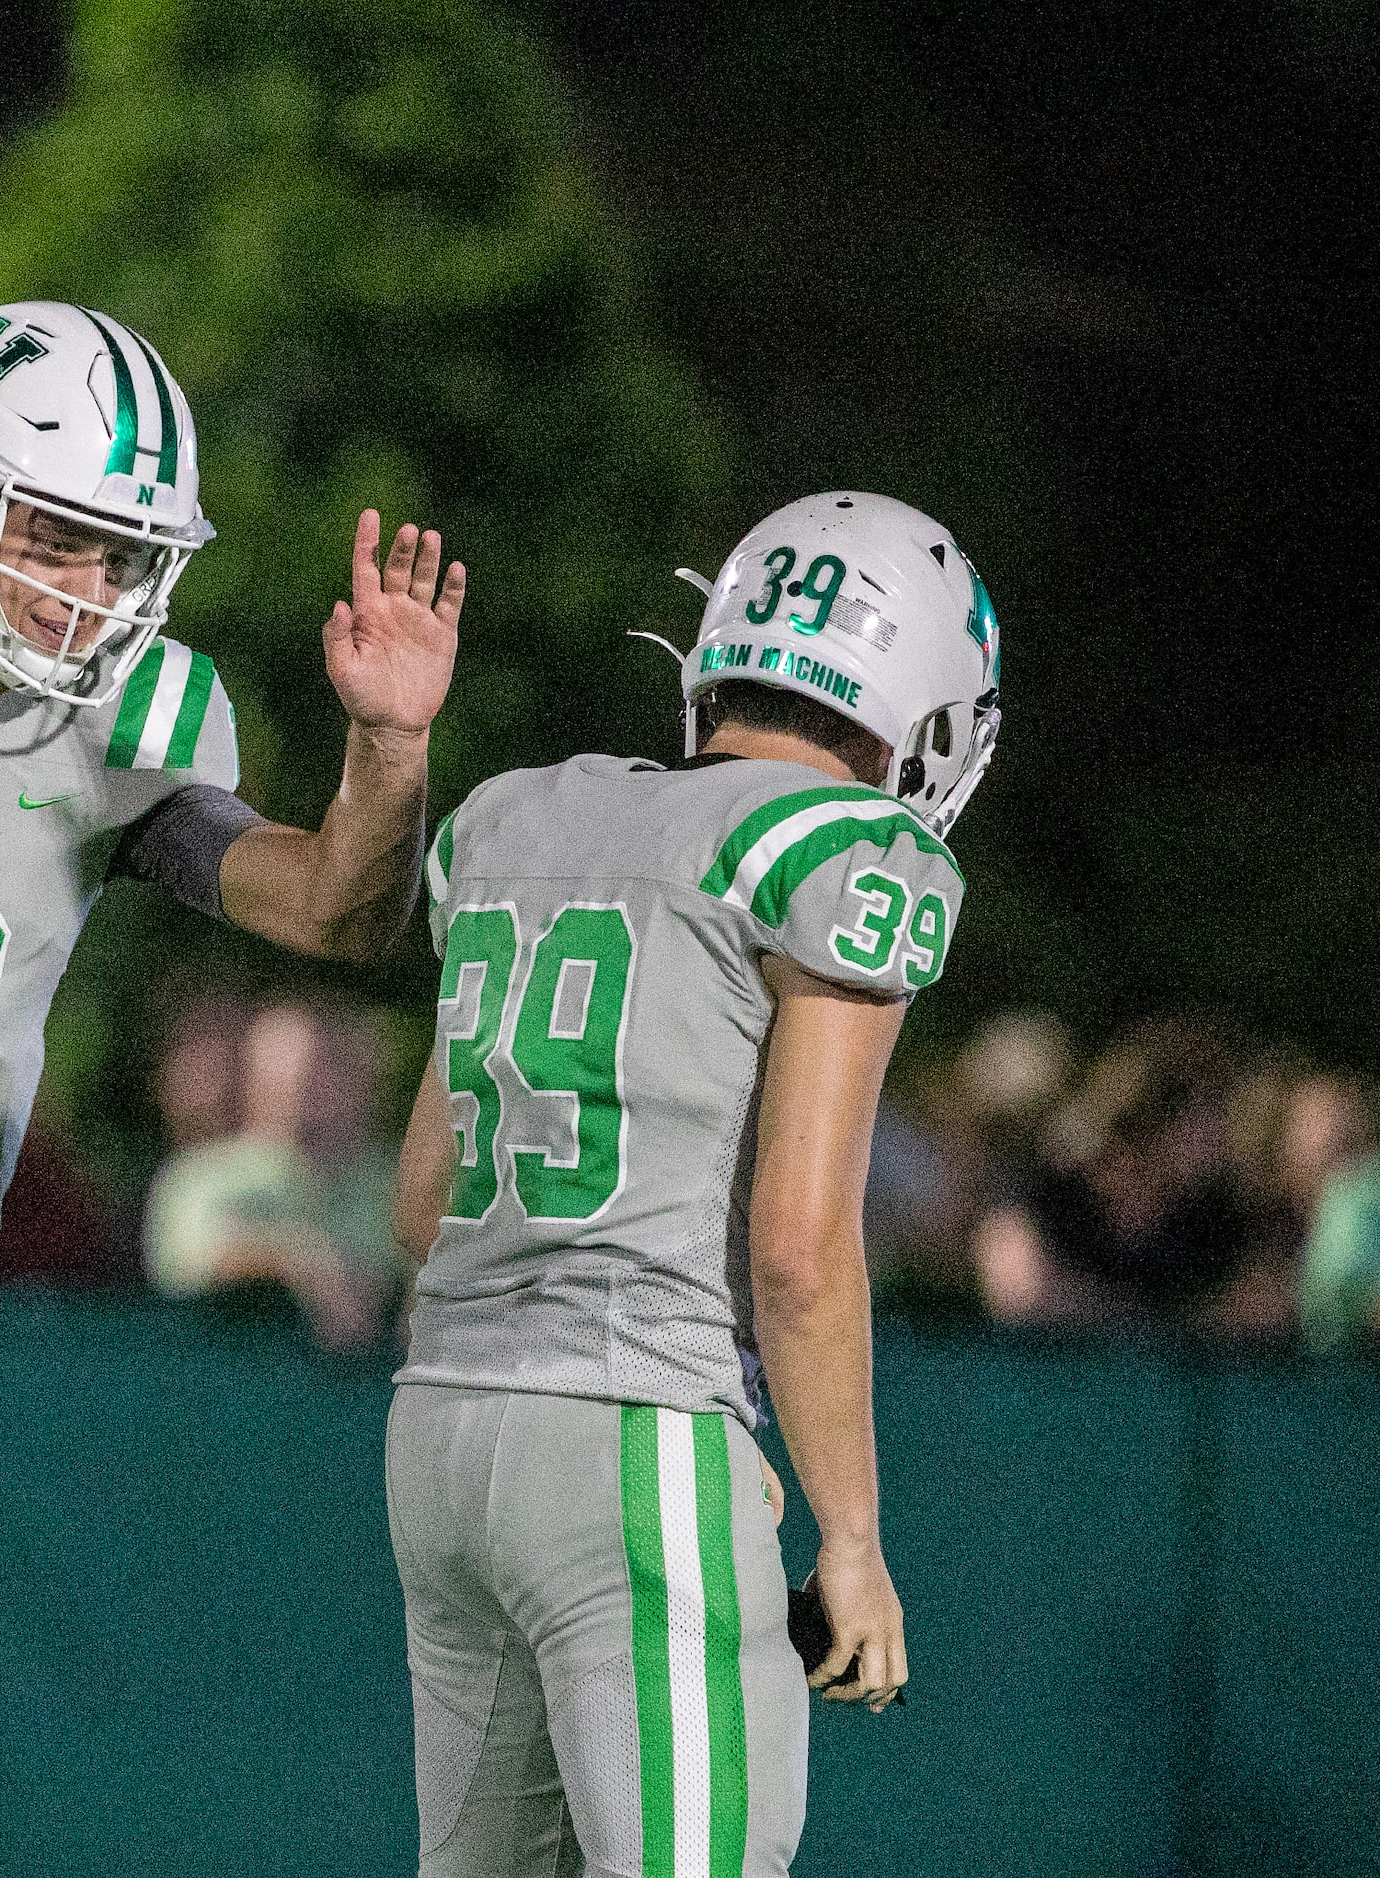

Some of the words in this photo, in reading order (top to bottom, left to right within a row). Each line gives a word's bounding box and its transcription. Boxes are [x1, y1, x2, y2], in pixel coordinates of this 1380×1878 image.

[136, 483, 156, 506] N
[746, 547, 846, 636] 39
[700, 644, 753, 672] MEAN
[759, 645, 863, 708] MACHINE
[828, 866, 951, 991] 39
[438, 901, 638, 1224] 39
